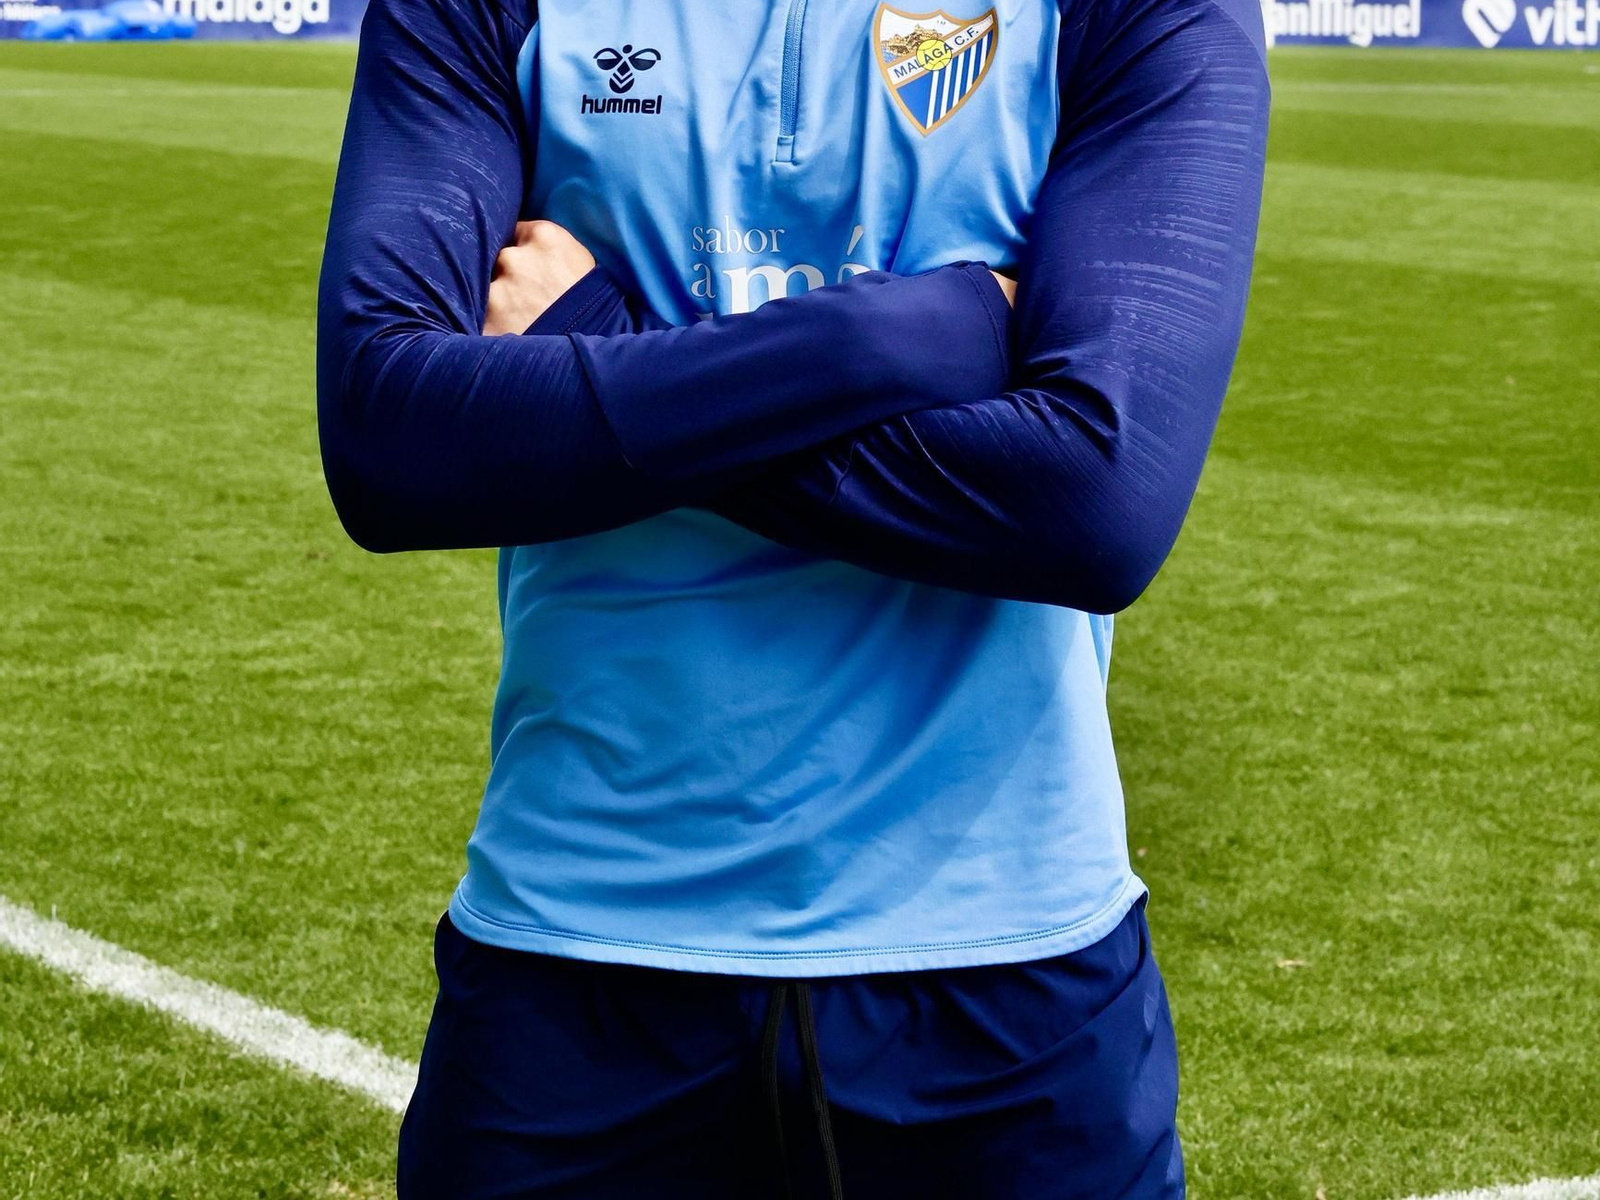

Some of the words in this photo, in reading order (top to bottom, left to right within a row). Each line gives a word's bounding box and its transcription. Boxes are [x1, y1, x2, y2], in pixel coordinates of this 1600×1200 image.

[893, 42, 954, 79] MALAGA
[954, 26, 980, 46] C.F.
[581, 94, 663, 114] hummel
[692, 215, 785, 254] sabor
[691, 262, 717, 300] a
